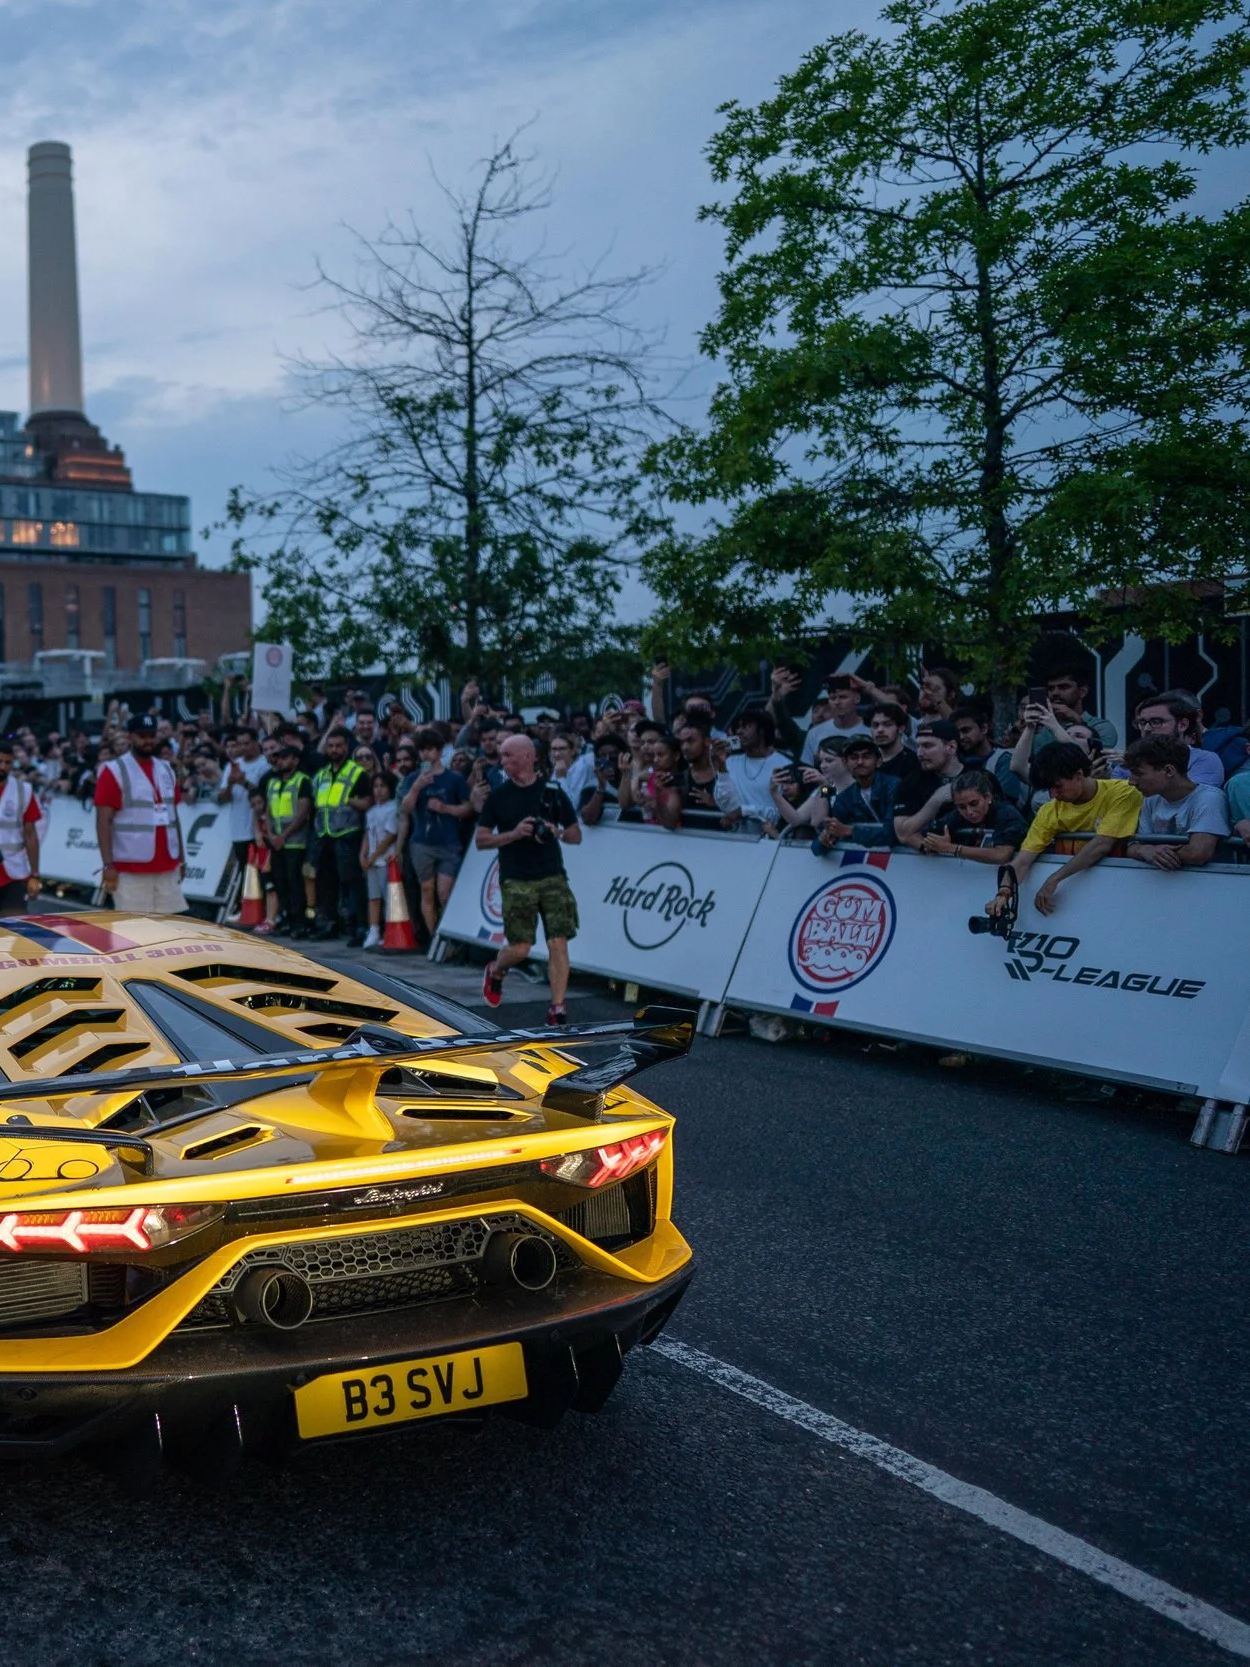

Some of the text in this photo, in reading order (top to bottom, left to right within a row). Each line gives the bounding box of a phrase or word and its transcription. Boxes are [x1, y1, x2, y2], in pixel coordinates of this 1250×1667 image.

[603, 876, 715, 928] Hard Rock
[147, 944, 225, 959] 3000
[342, 1357, 484, 1423] B3 SVJ
